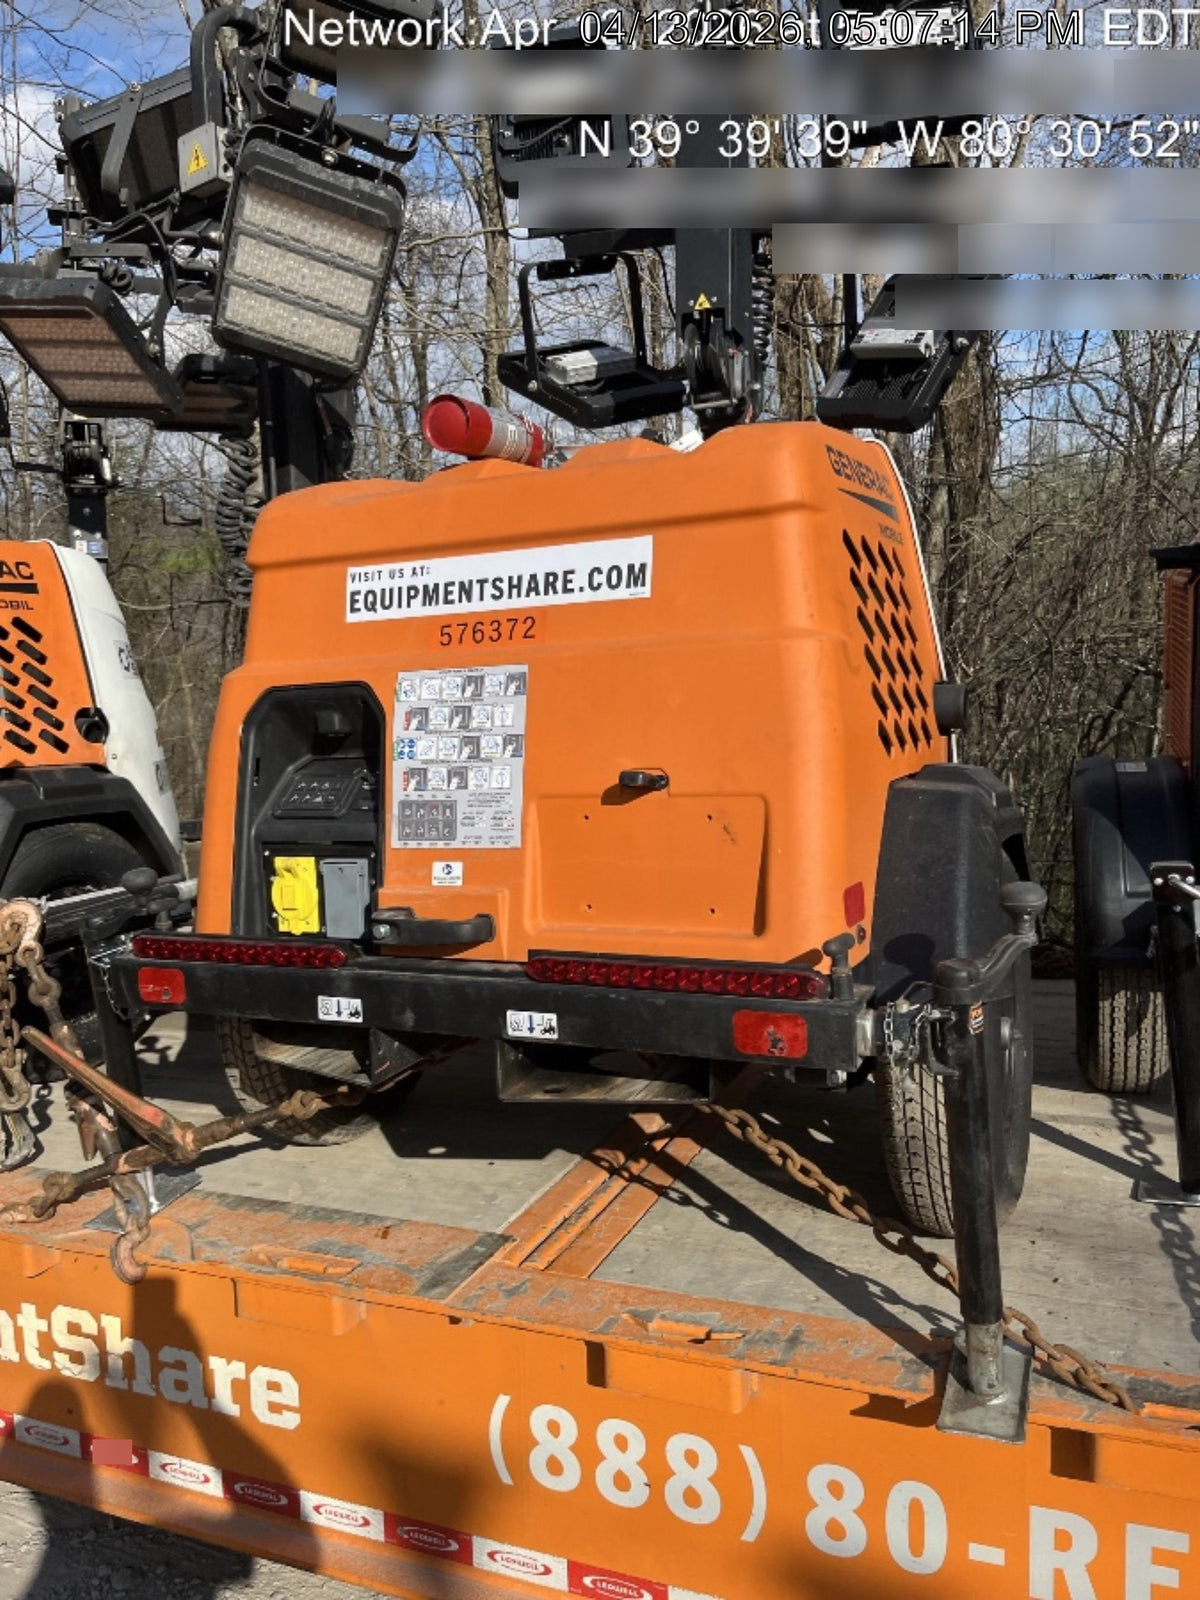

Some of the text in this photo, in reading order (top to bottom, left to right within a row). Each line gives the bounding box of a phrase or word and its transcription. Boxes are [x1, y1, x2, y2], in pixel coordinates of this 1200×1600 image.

[349, 562, 648, 614] EQUIPMENTSHARE.COM
[350, 565, 432, 584] VISIT US AT:
[439, 616, 537, 646] 576372
[488, 1393, 767, 1543] (888)
[596, 1579, 640, 1598] LEDWELL
